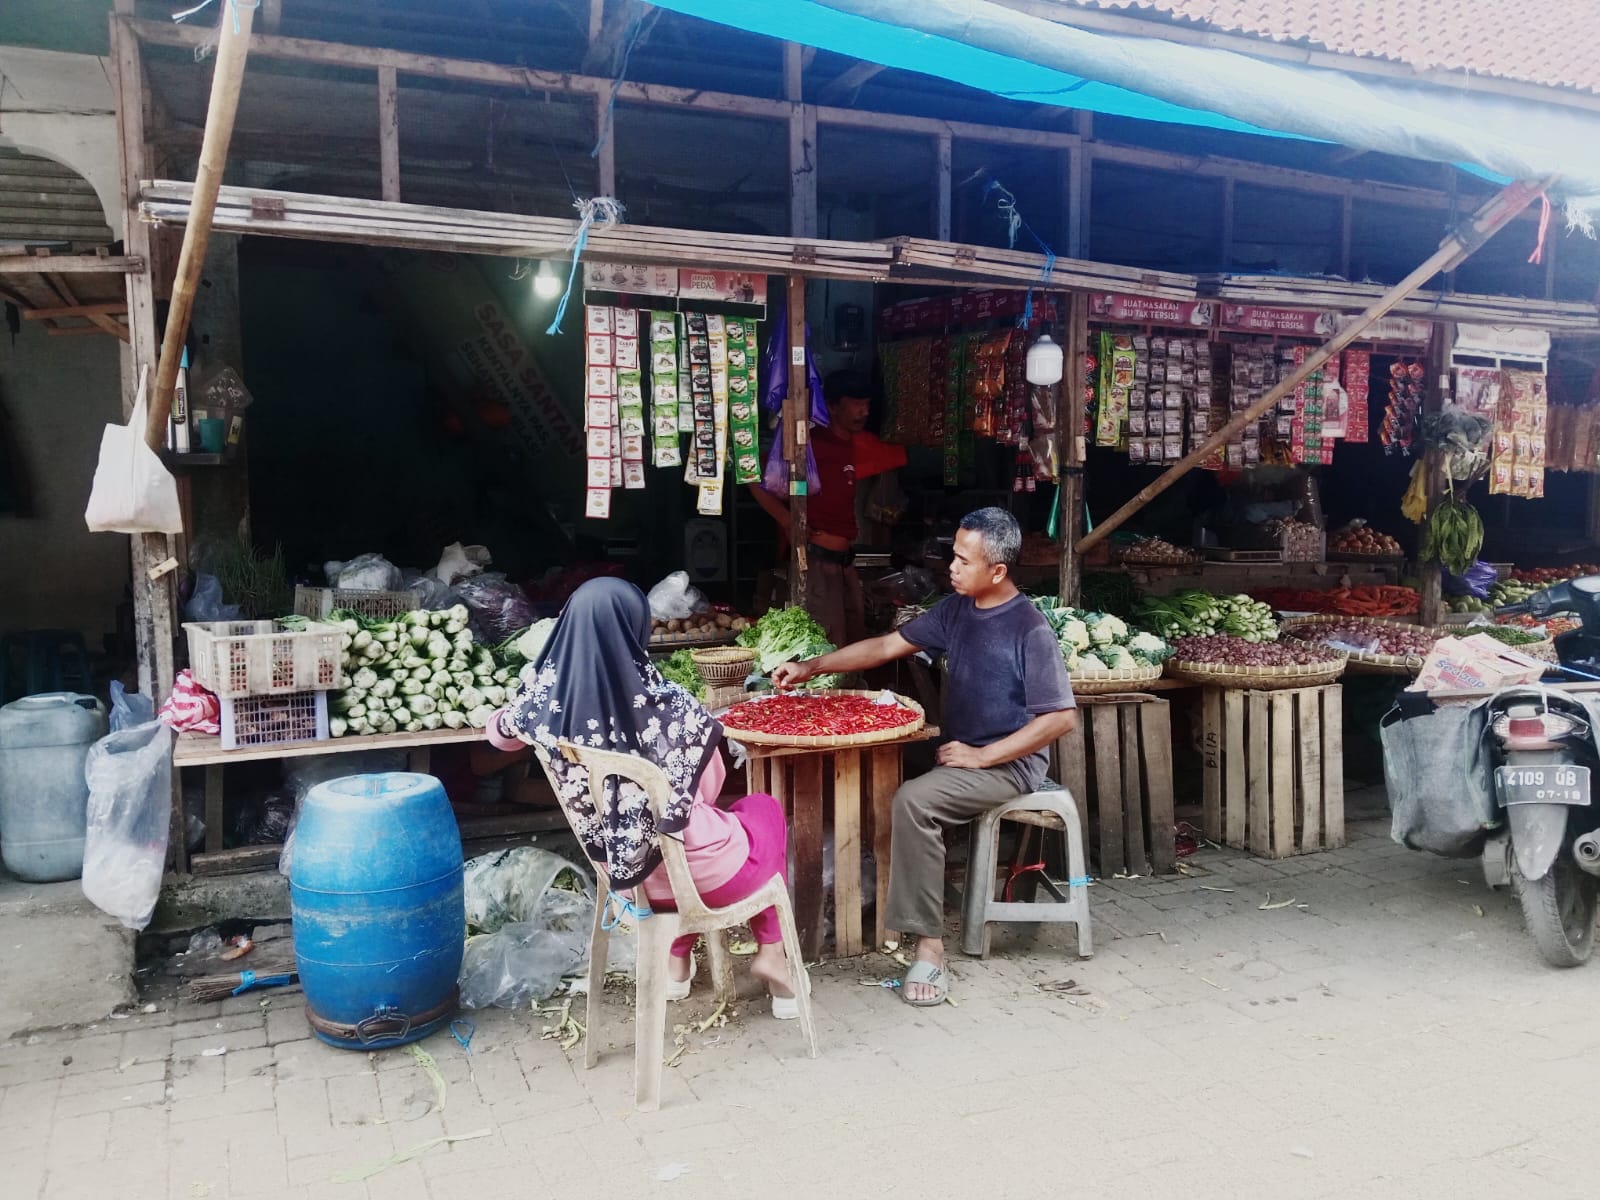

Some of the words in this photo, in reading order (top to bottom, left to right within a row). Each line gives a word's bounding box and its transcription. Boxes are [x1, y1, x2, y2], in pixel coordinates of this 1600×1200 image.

[1142, 301, 1179, 310] MASAKAN
[478, 302, 525, 368] SASA
[518, 366, 585, 457] SANTAN
[1507, 771, 1545, 786] 4109
